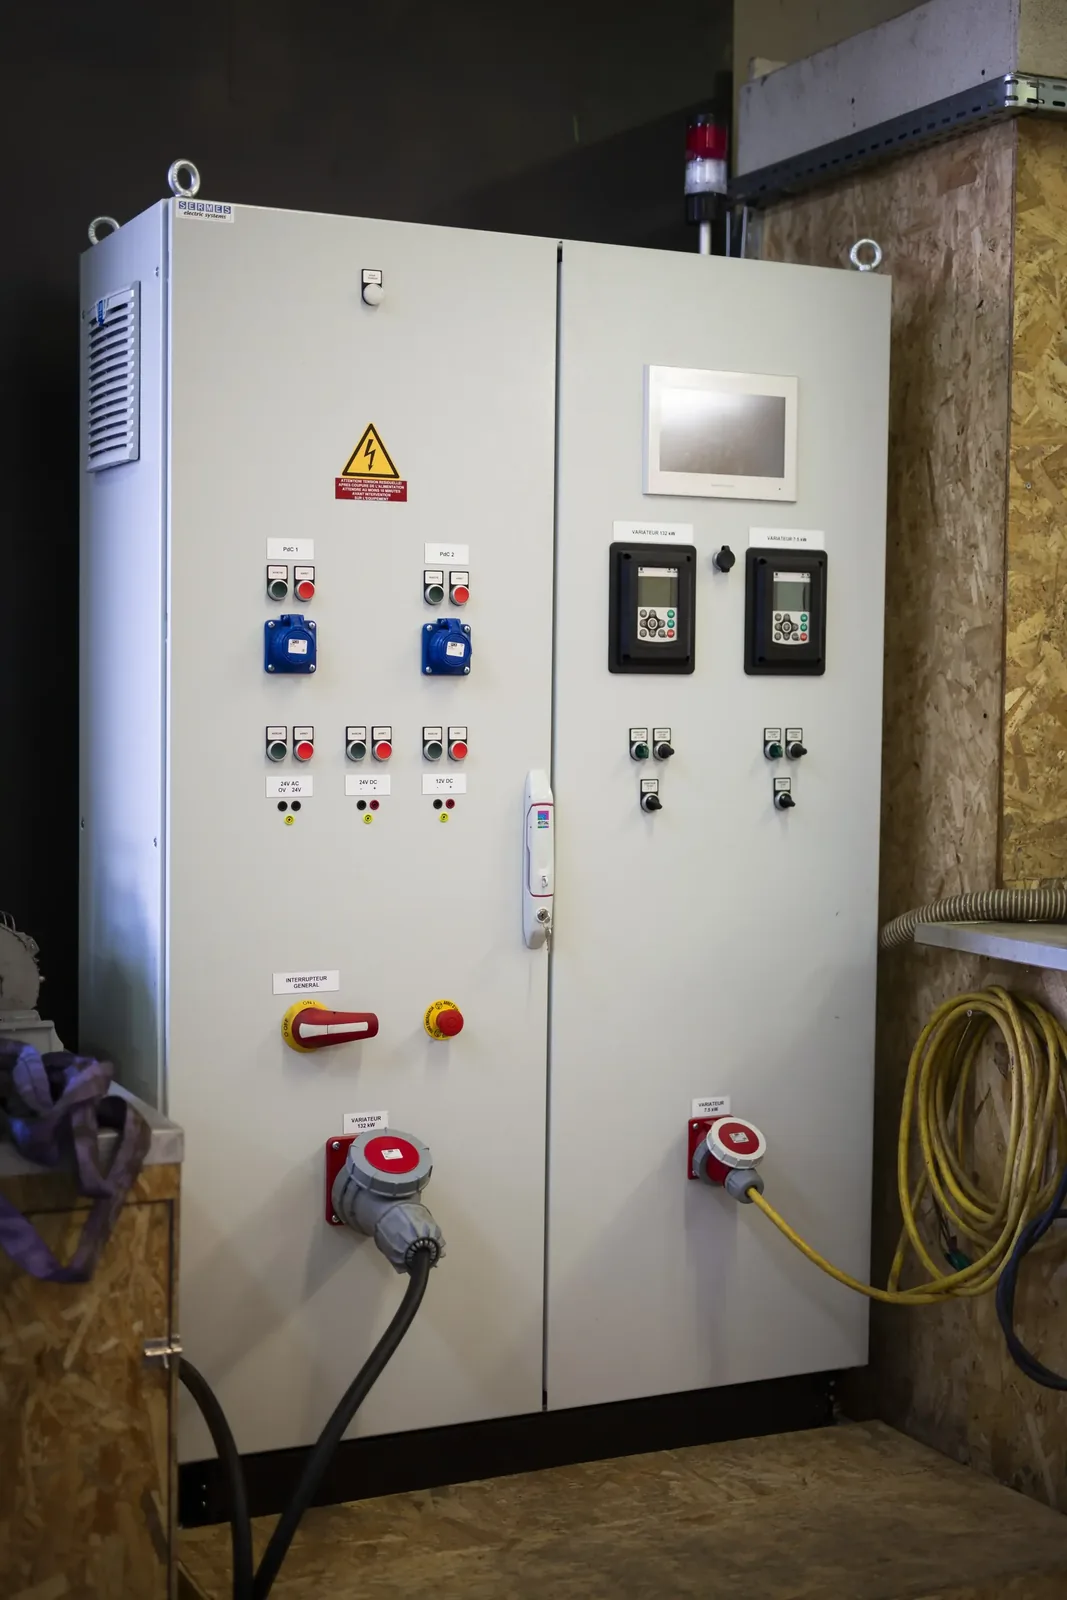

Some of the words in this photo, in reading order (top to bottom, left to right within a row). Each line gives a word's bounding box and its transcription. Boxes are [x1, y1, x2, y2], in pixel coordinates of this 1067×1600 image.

[179, 201, 231, 214] SERMES
[286, 975, 327, 983] INTERRUPTEUR
[351, 1115, 382, 1123] VARIATEUR
